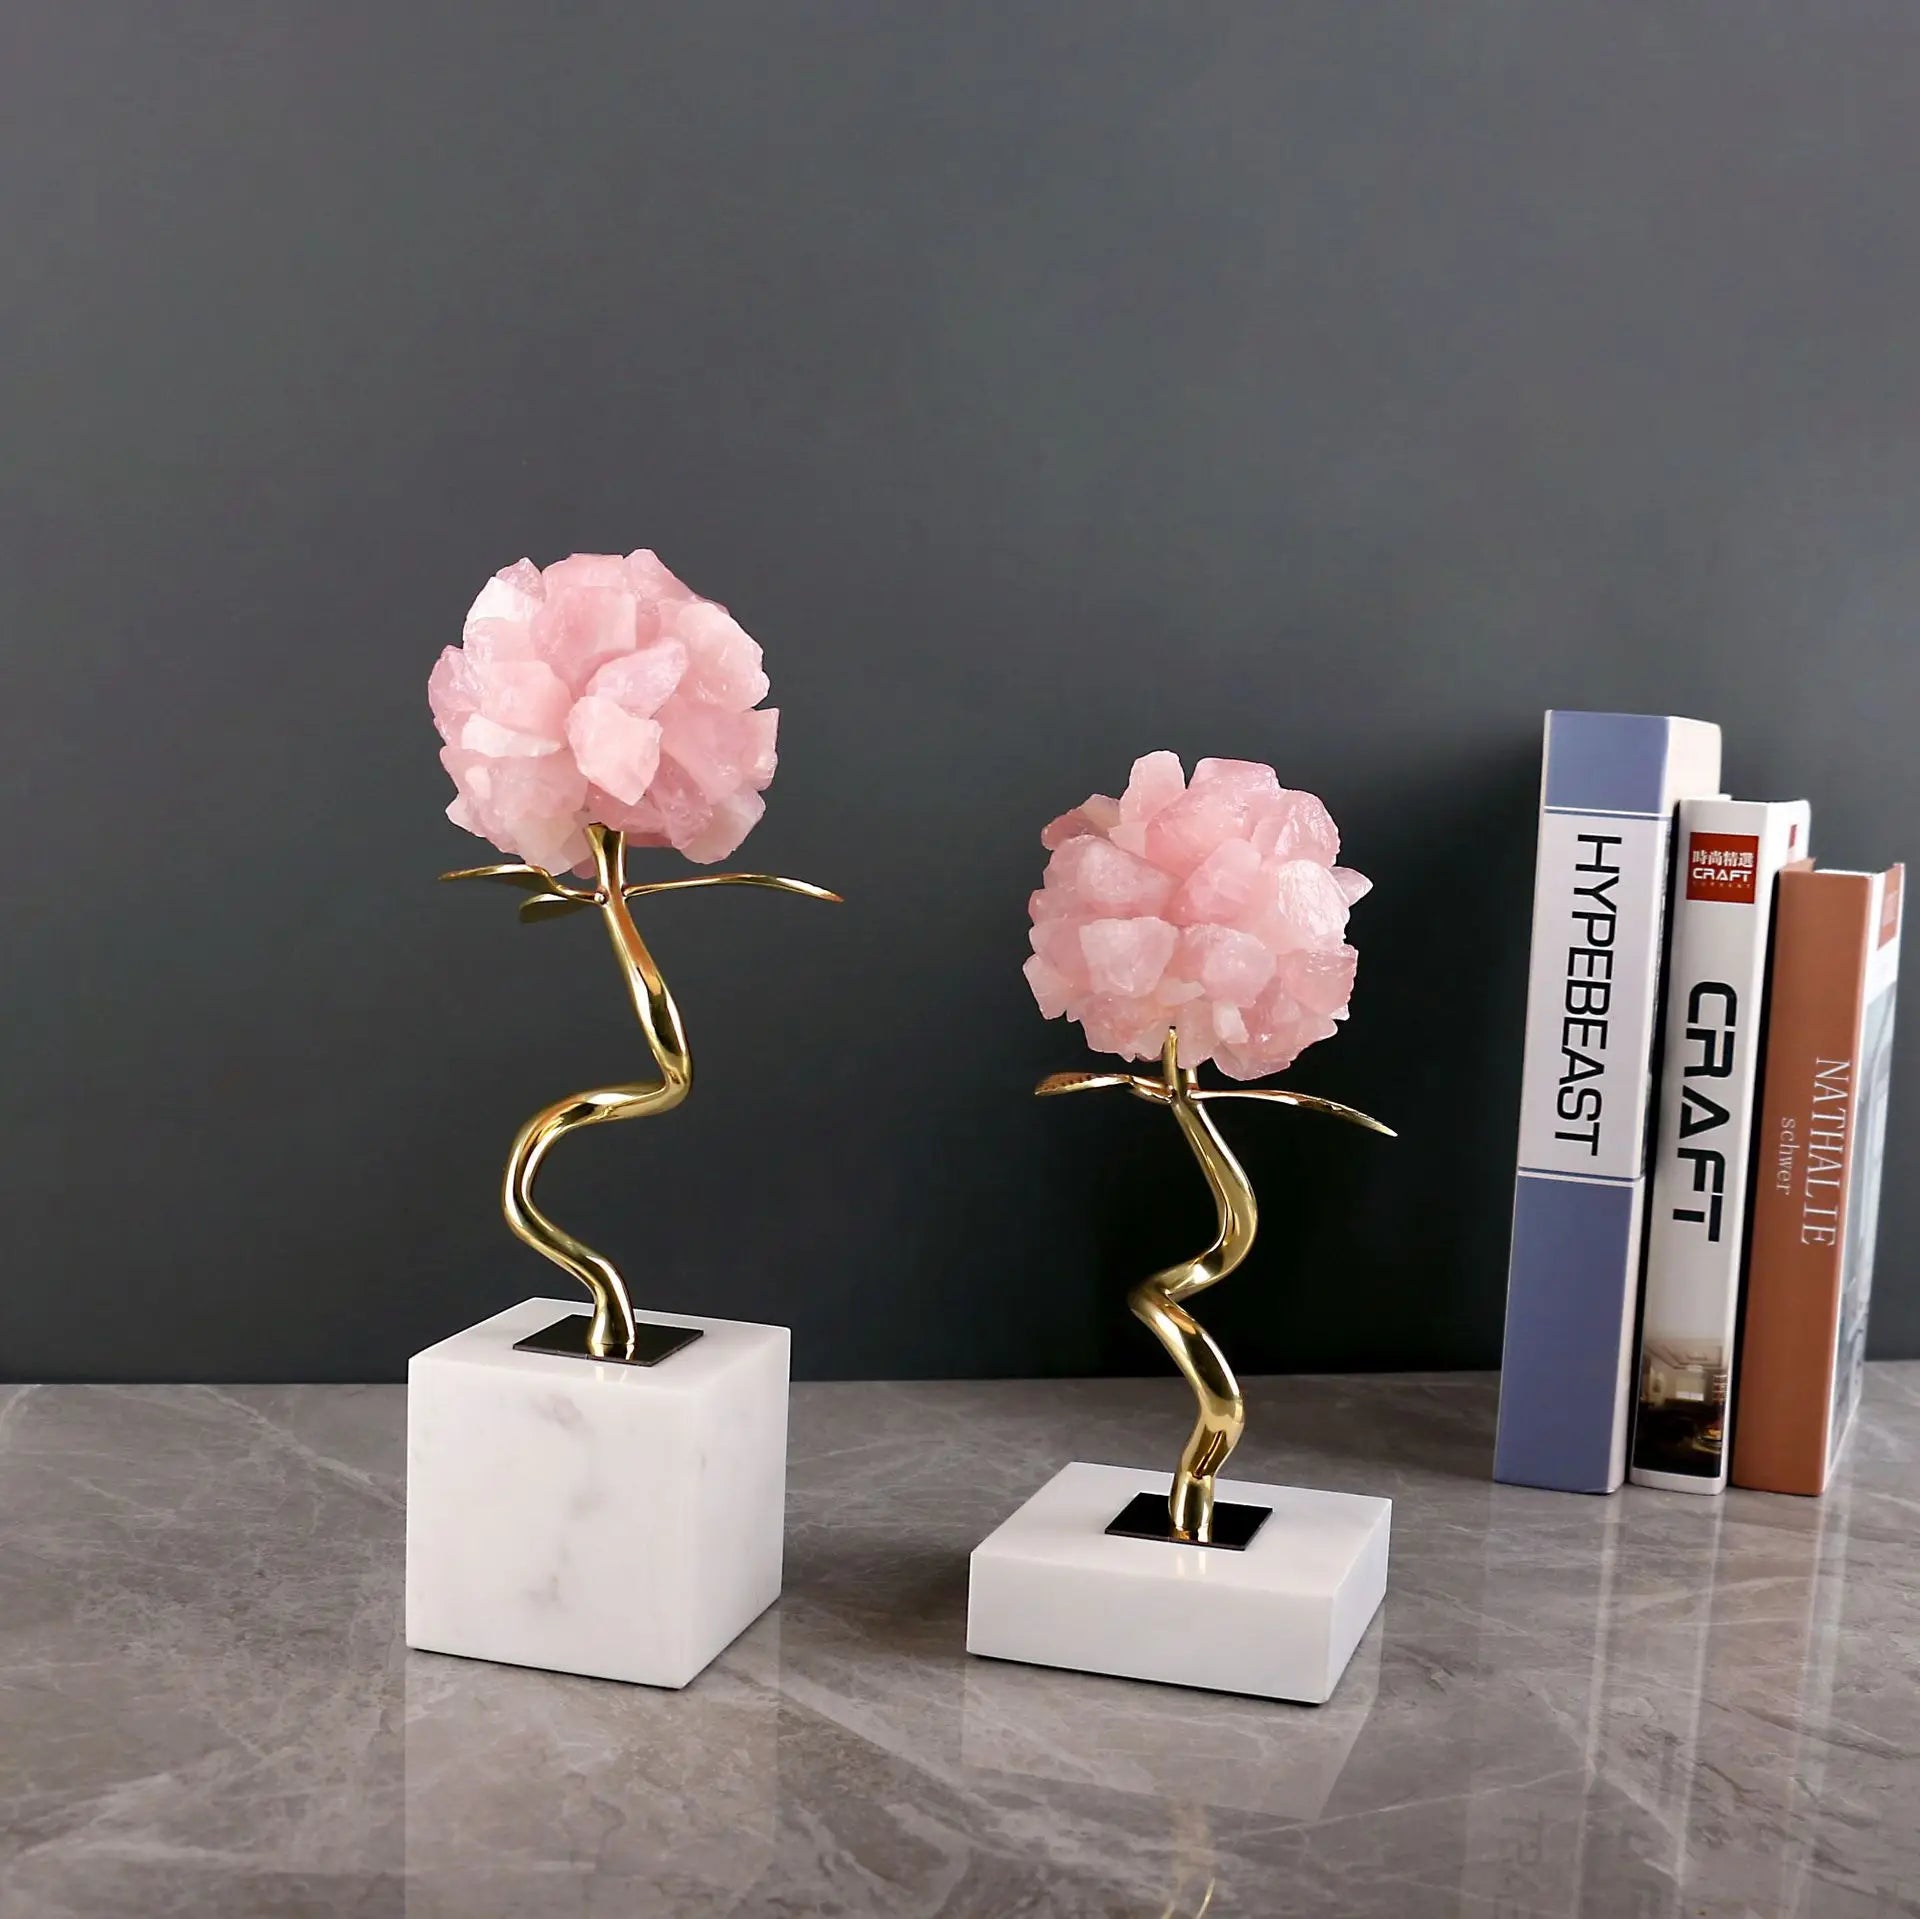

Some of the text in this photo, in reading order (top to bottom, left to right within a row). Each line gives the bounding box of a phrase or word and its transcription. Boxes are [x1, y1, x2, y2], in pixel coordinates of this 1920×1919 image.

[1692, 849, 1754, 868] 時尚精選
[1692, 868, 1753, 883] CRAFT
[1554, 833, 1622, 1157] HYPEBEAST
[1672, 981, 1738, 1242] CRAFT
[1776, 1117, 1800, 1195] schwer
[1801, 1056, 1851, 1246] NATHALIE
